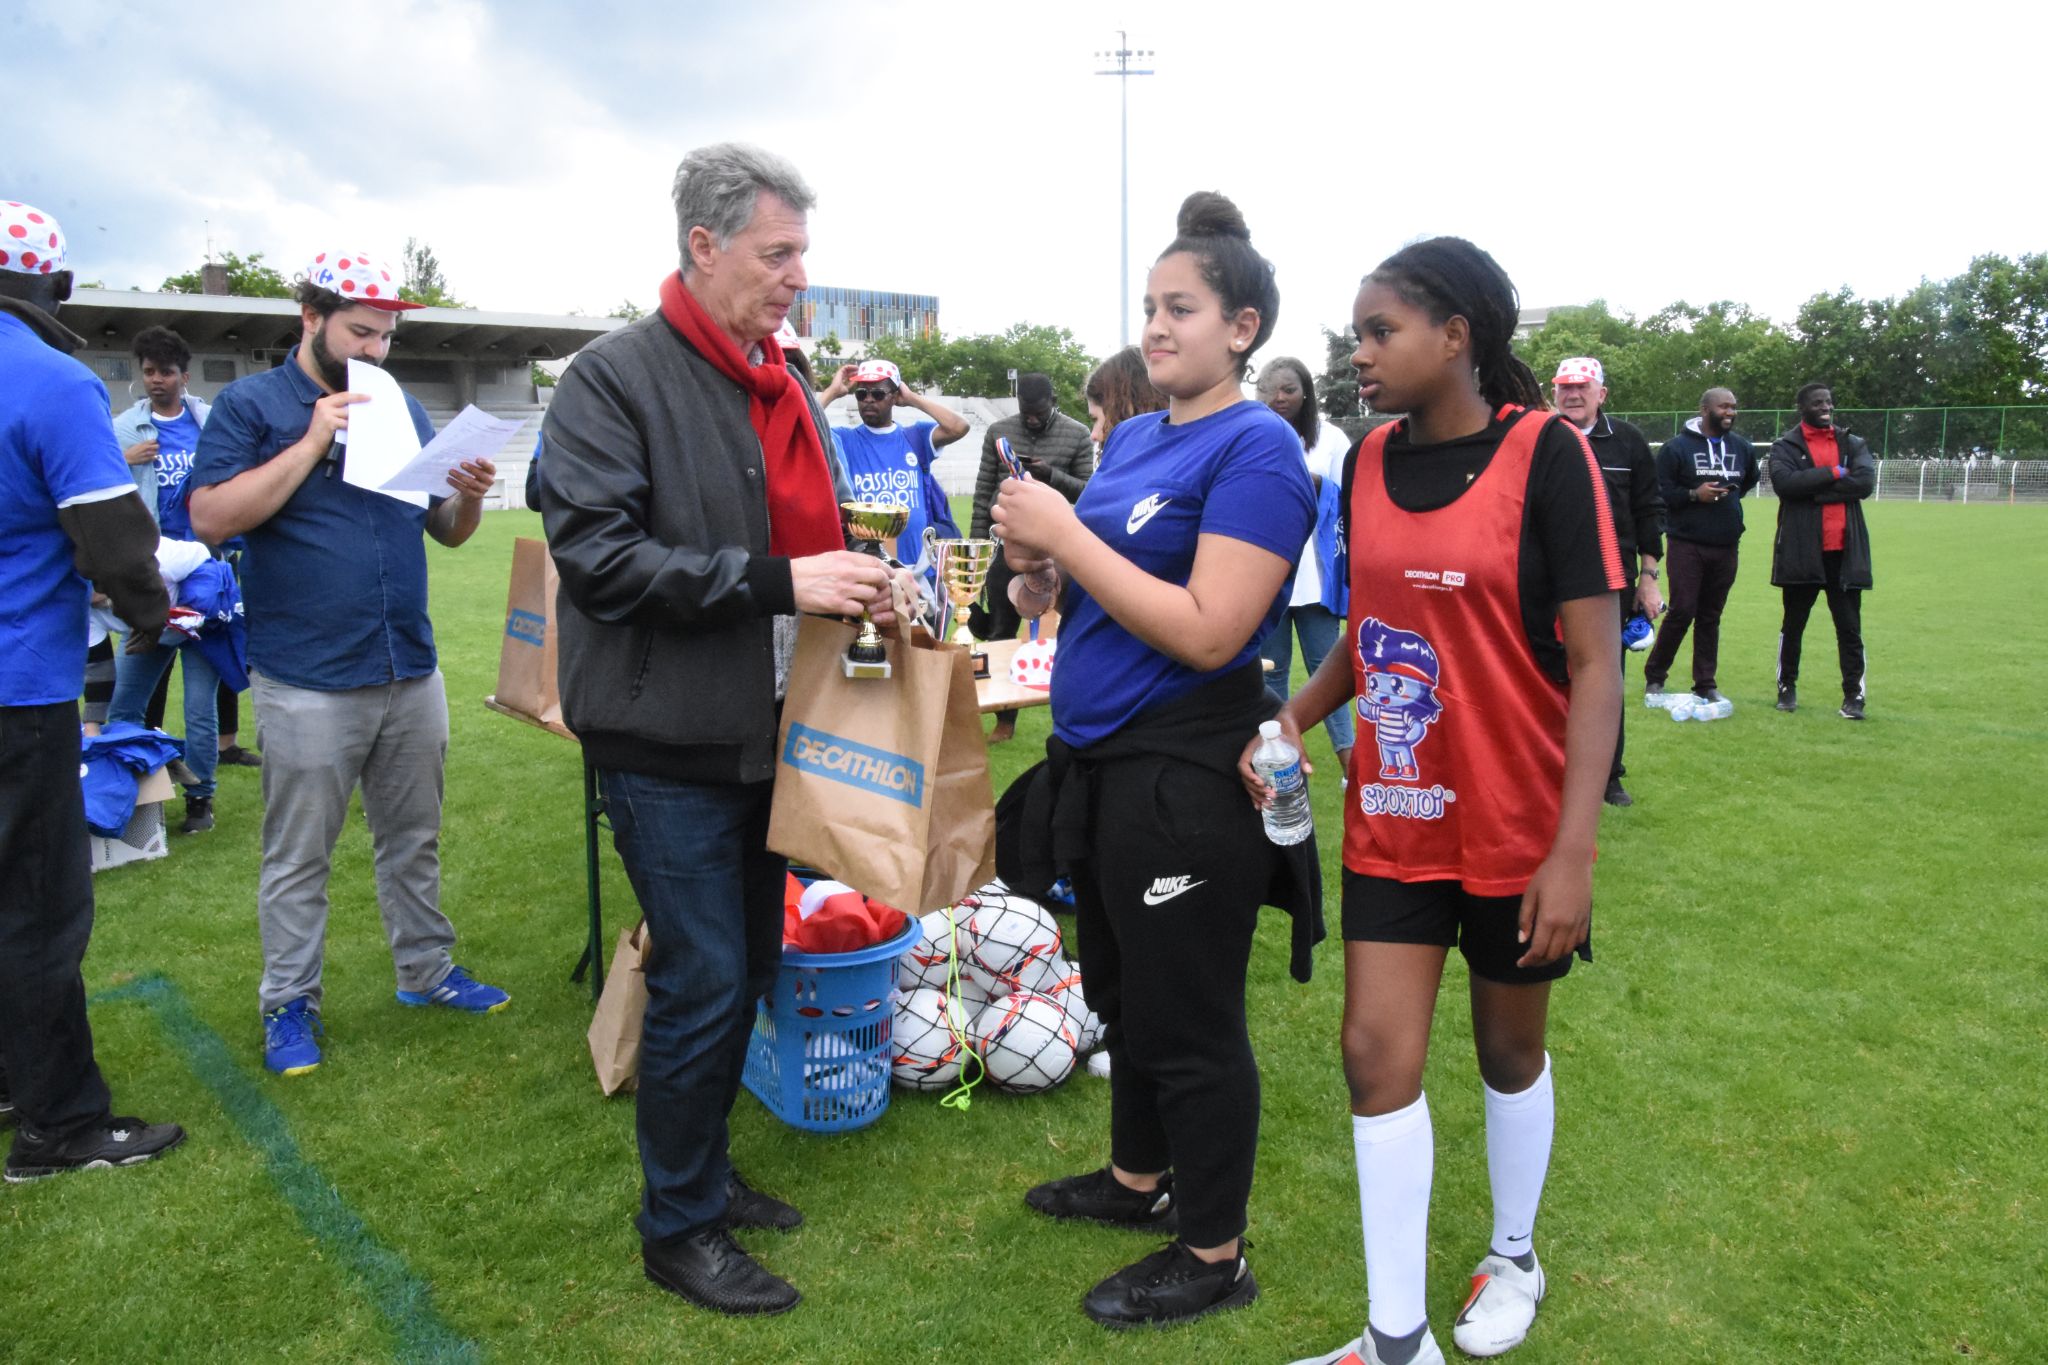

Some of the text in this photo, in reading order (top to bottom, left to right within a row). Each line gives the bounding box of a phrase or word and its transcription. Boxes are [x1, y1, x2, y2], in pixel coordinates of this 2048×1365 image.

[1131, 493, 1160, 520] NIKE
[1404, 569, 1463, 583] DECATHLON PRO
[793, 735, 917, 797] DECATHLON
[1150, 874, 1192, 894] NIKE
